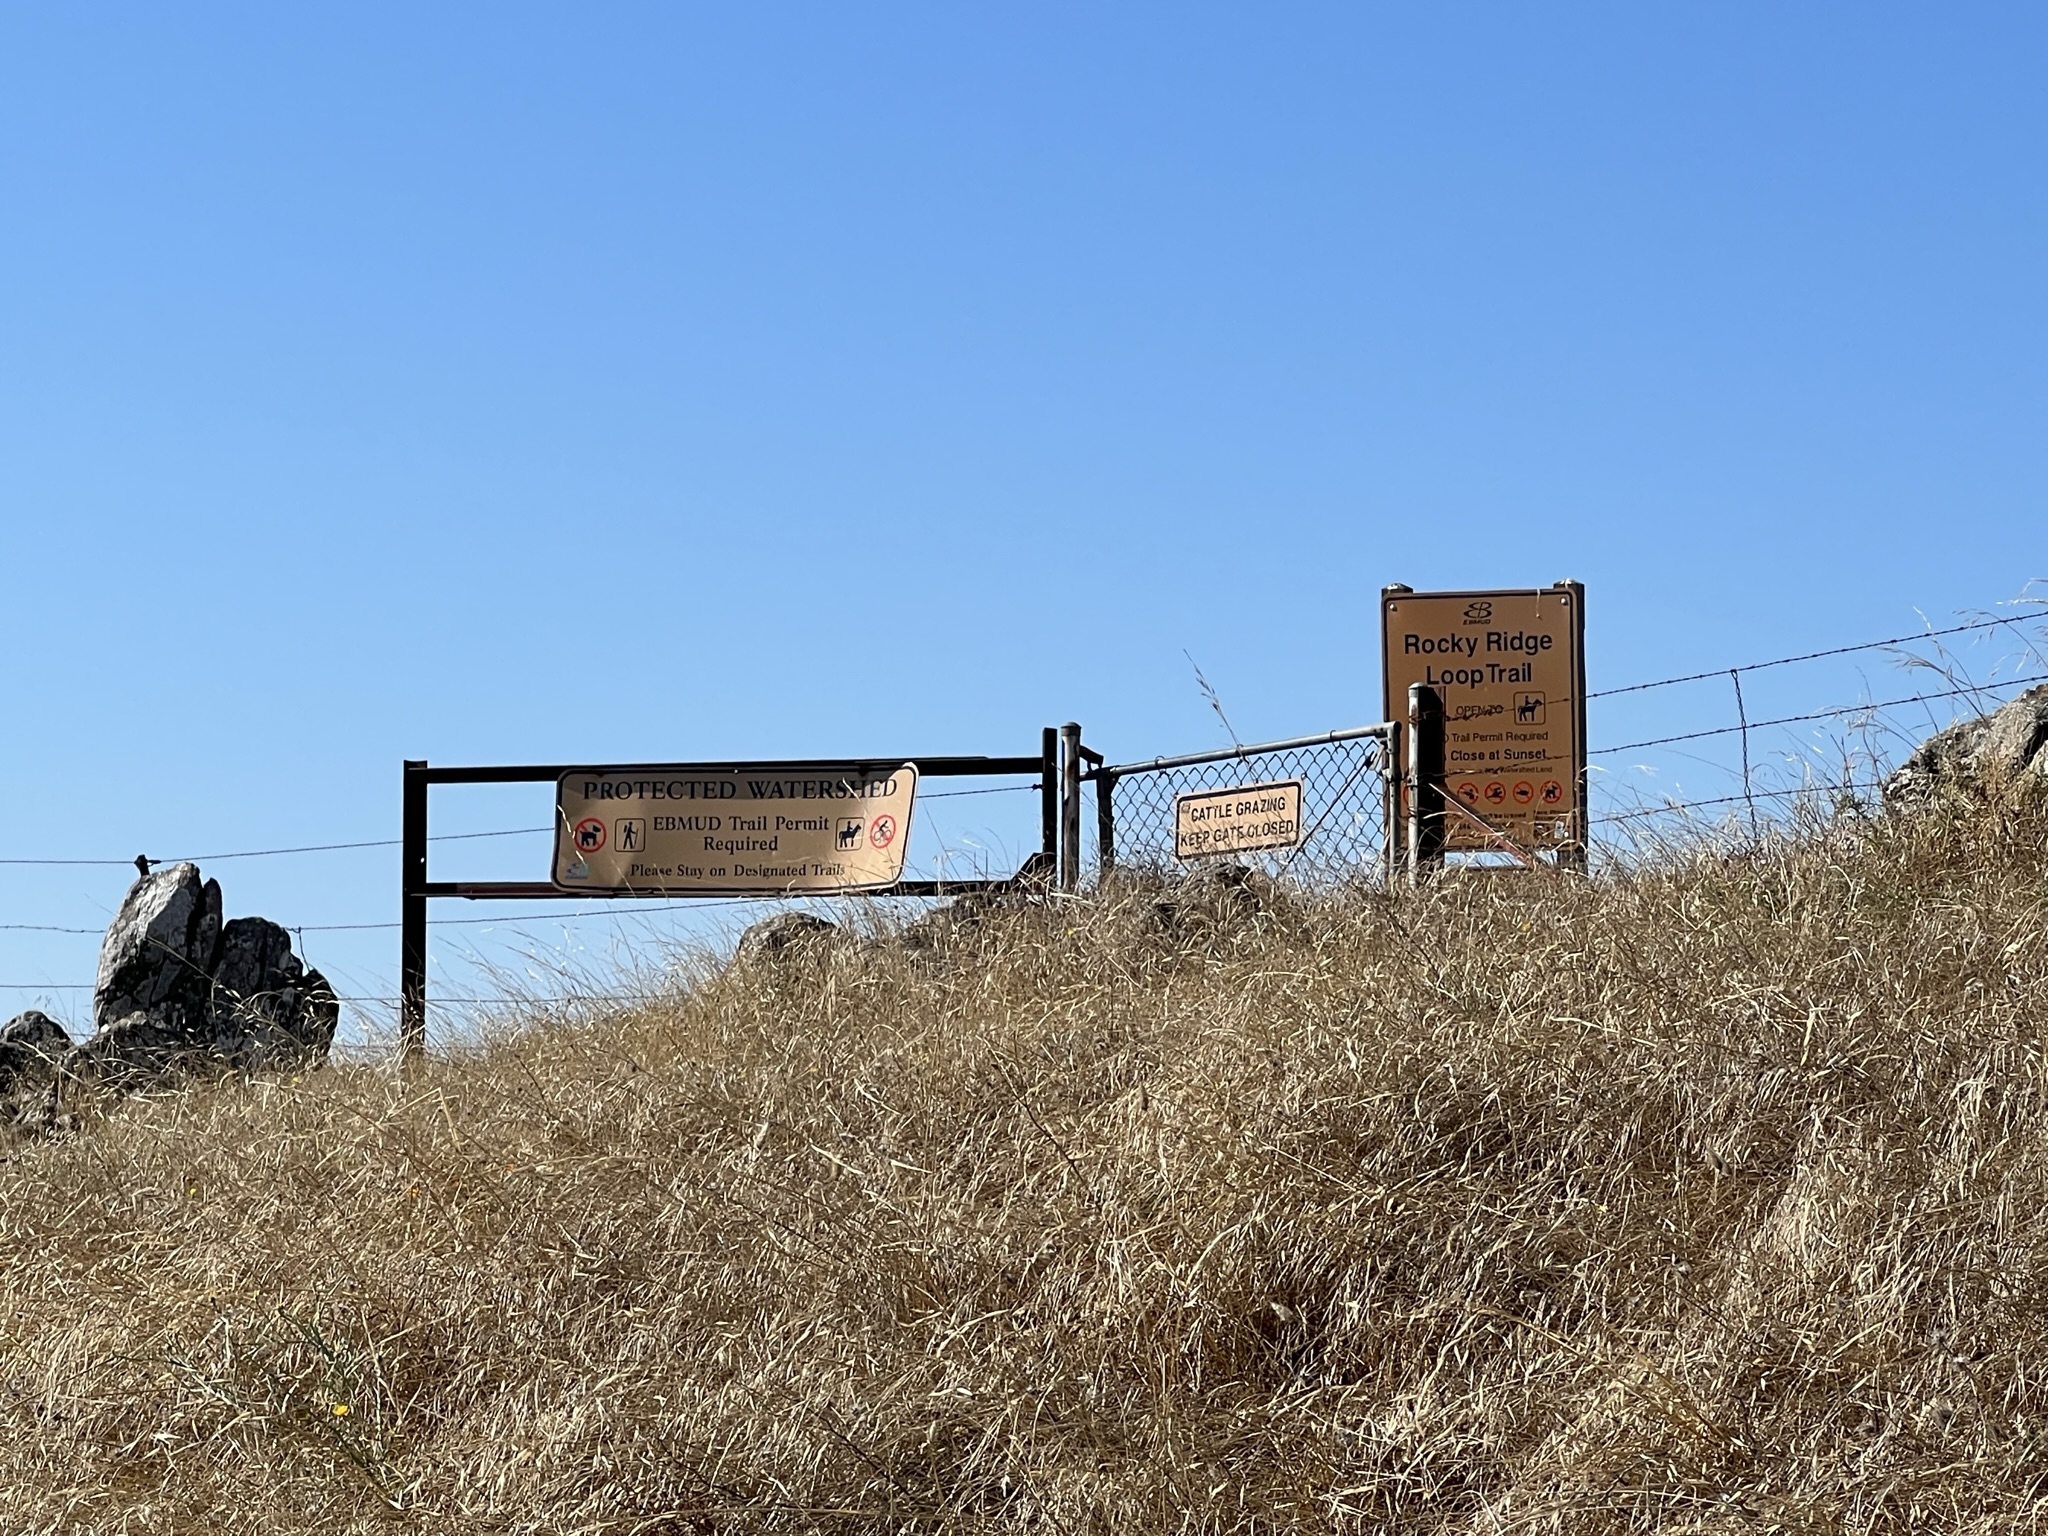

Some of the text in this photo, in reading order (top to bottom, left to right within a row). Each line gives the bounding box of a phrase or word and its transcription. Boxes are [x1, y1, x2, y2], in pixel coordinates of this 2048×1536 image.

[1404, 631, 1553, 657] Rocky Ridge
[1426, 663, 1532, 689] Loop Trail
[1456, 705, 1485, 716] OPEN
[1452, 733, 1470, 742] Trail
[1472, 732, 1503, 742] Permit
[1506, 731, 1548, 742] Required
[1451, 748, 1547, 761] Close at Sunset
[583, 778, 898, 800] PROTECTED WATERSHED
[1191, 803, 1232, 822] CATTLE
[1236, 796, 1286, 816] GRAZING
[653, 816, 830, 831] EBMUD Trail Permit
[1180, 820, 1294, 847] KEEP GATE CLOSED
[703, 836, 778, 855] Required
[630, 862, 845, 880] Please Stay on Designated Trails
